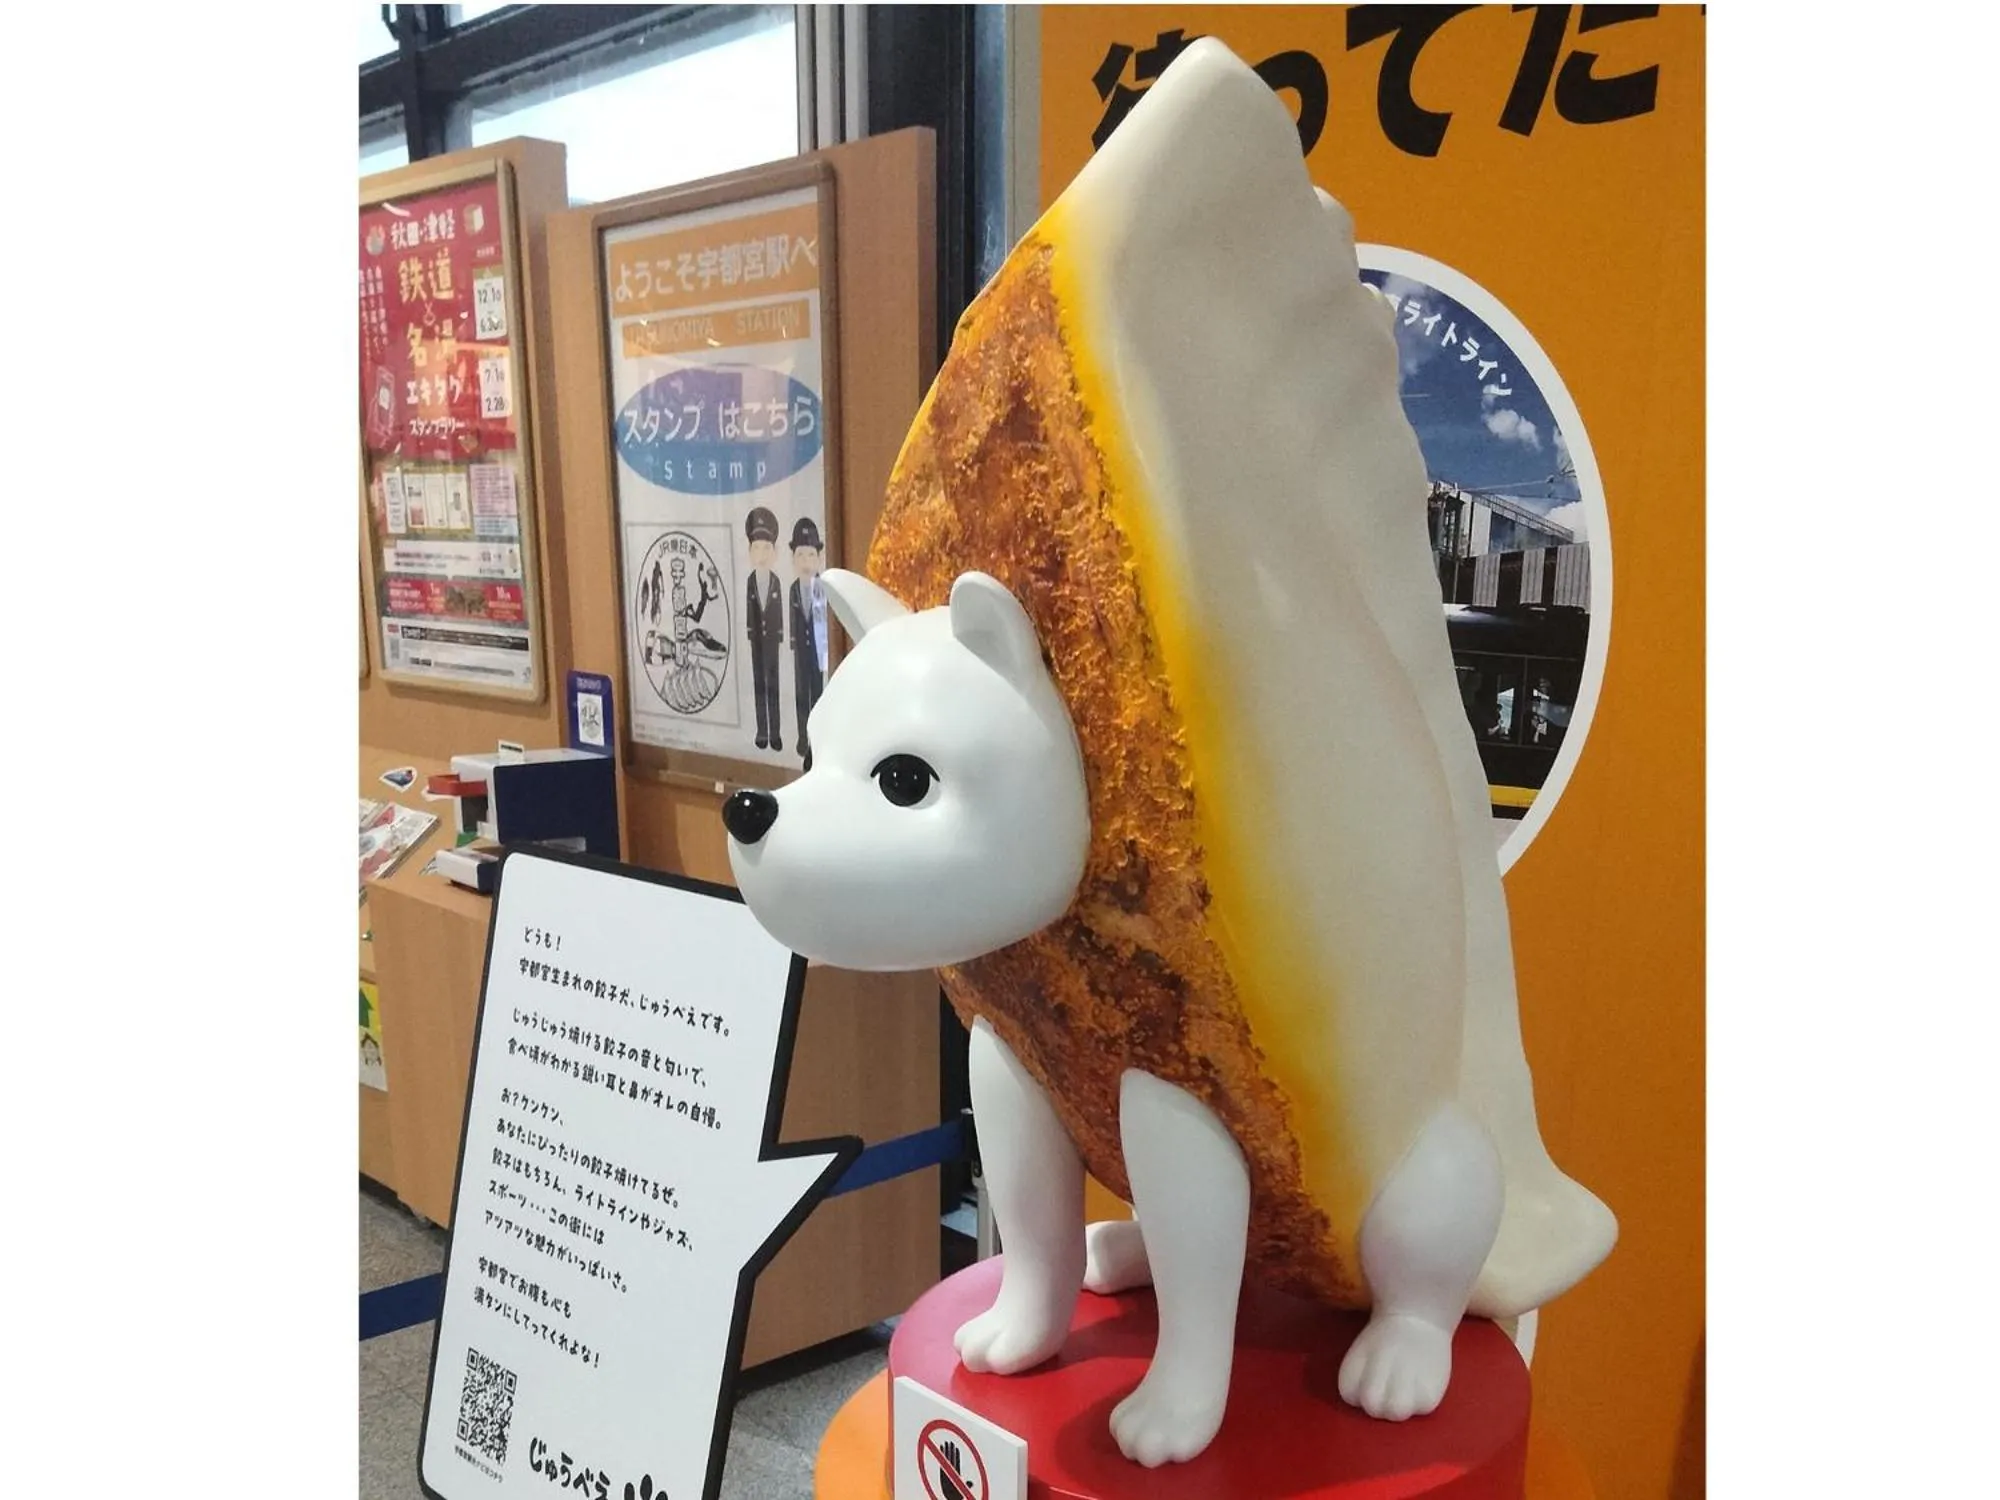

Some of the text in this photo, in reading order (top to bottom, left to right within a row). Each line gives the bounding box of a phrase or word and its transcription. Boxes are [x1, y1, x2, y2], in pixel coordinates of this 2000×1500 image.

[398, 247, 455, 304] 鉄道
[614, 232, 819, 303] ようこそ宇都宮駅へ
[734, 305, 800, 335] STATION
[1384, 294, 1513, 397] ライトライン
[408, 416, 466, 437] スタンプラリー
[623, 395, 815, 444] スタンプ はこちら
[519, 957, 730, 1037] 宇都宮生まれの餃子犬、じゅうべえです。
[512, 1007, 707, 1087] じゅうじゅう焼ける餃子の音と匂いで、
[507, 1037, 721, 1130] 食べ頃がわかる鋭い耳と鼻がオレの自慢。
[478, 1256, 571, 1319] 宇都宮でお腹も心も
[529, 1436, 611, 1500] じゅうべえ
